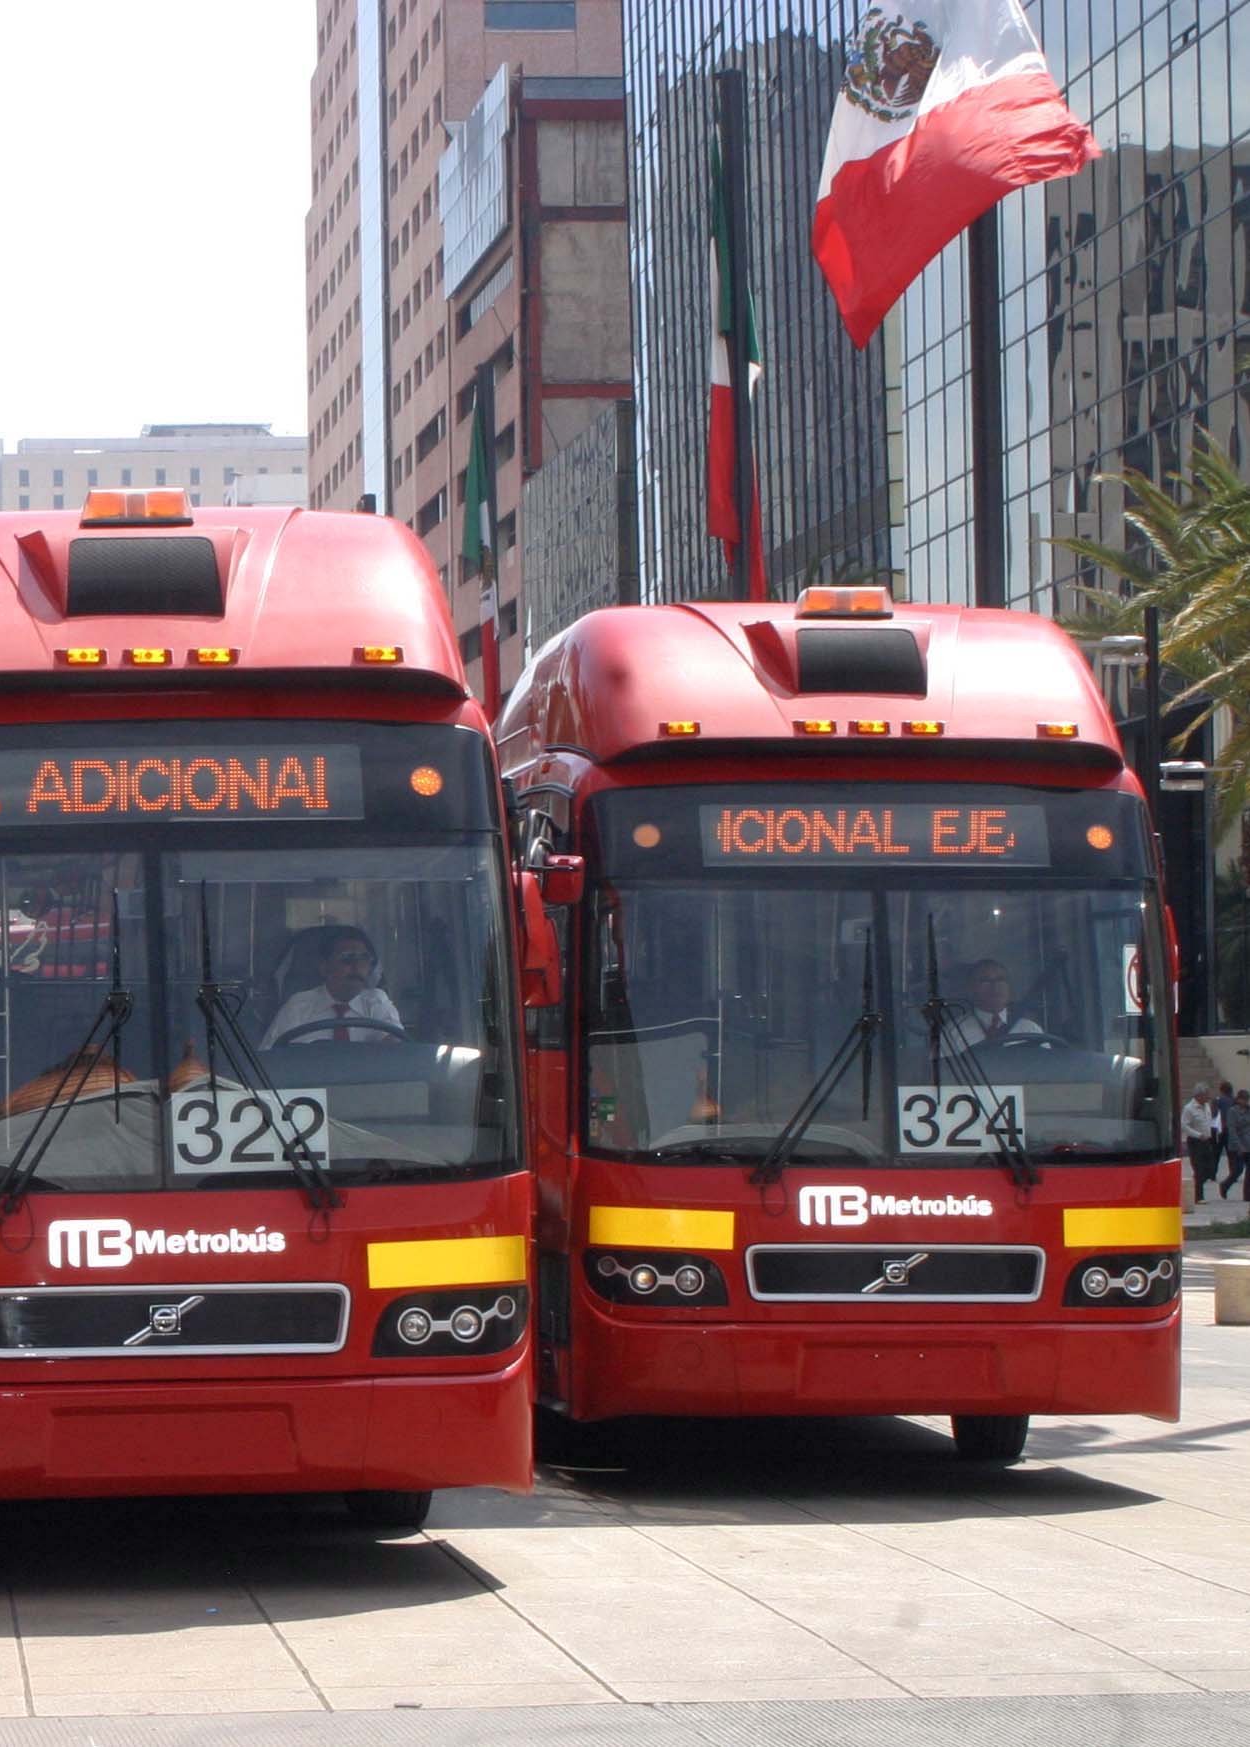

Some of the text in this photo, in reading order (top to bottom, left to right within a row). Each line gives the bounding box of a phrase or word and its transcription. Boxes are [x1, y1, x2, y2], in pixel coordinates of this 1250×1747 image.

[177, 1096, 327, 1166] 322
[902, 1093, 1024, 1148] 324
[870, 1194, 993, 1217] Metrobús
[135, 1225, 287, 1255] Metrobús
